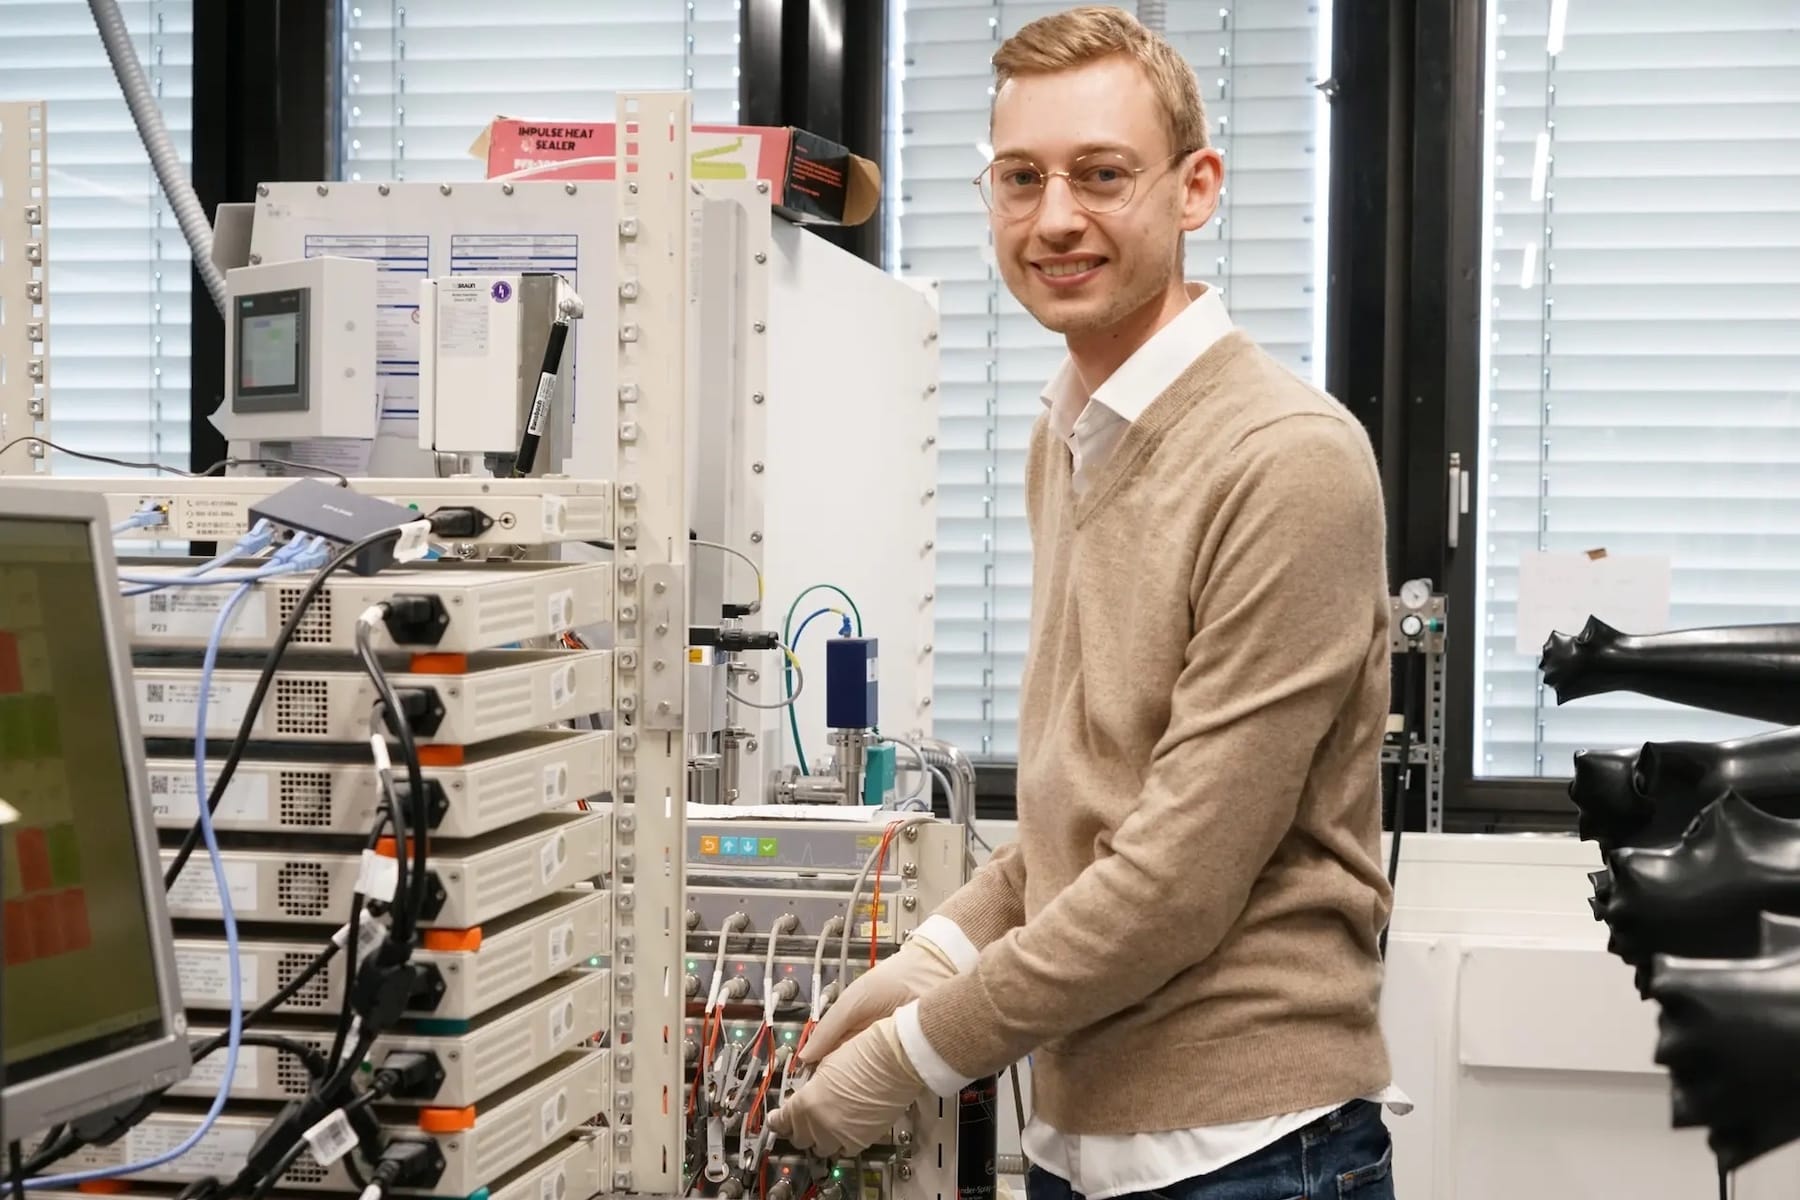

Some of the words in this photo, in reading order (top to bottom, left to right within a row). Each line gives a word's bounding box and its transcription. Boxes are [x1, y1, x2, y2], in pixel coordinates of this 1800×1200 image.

[518, 127, 563, 138] IMPULSE
[564, 128, 595, 139] HEAT
[535, 140, 576, 151] SEALER
